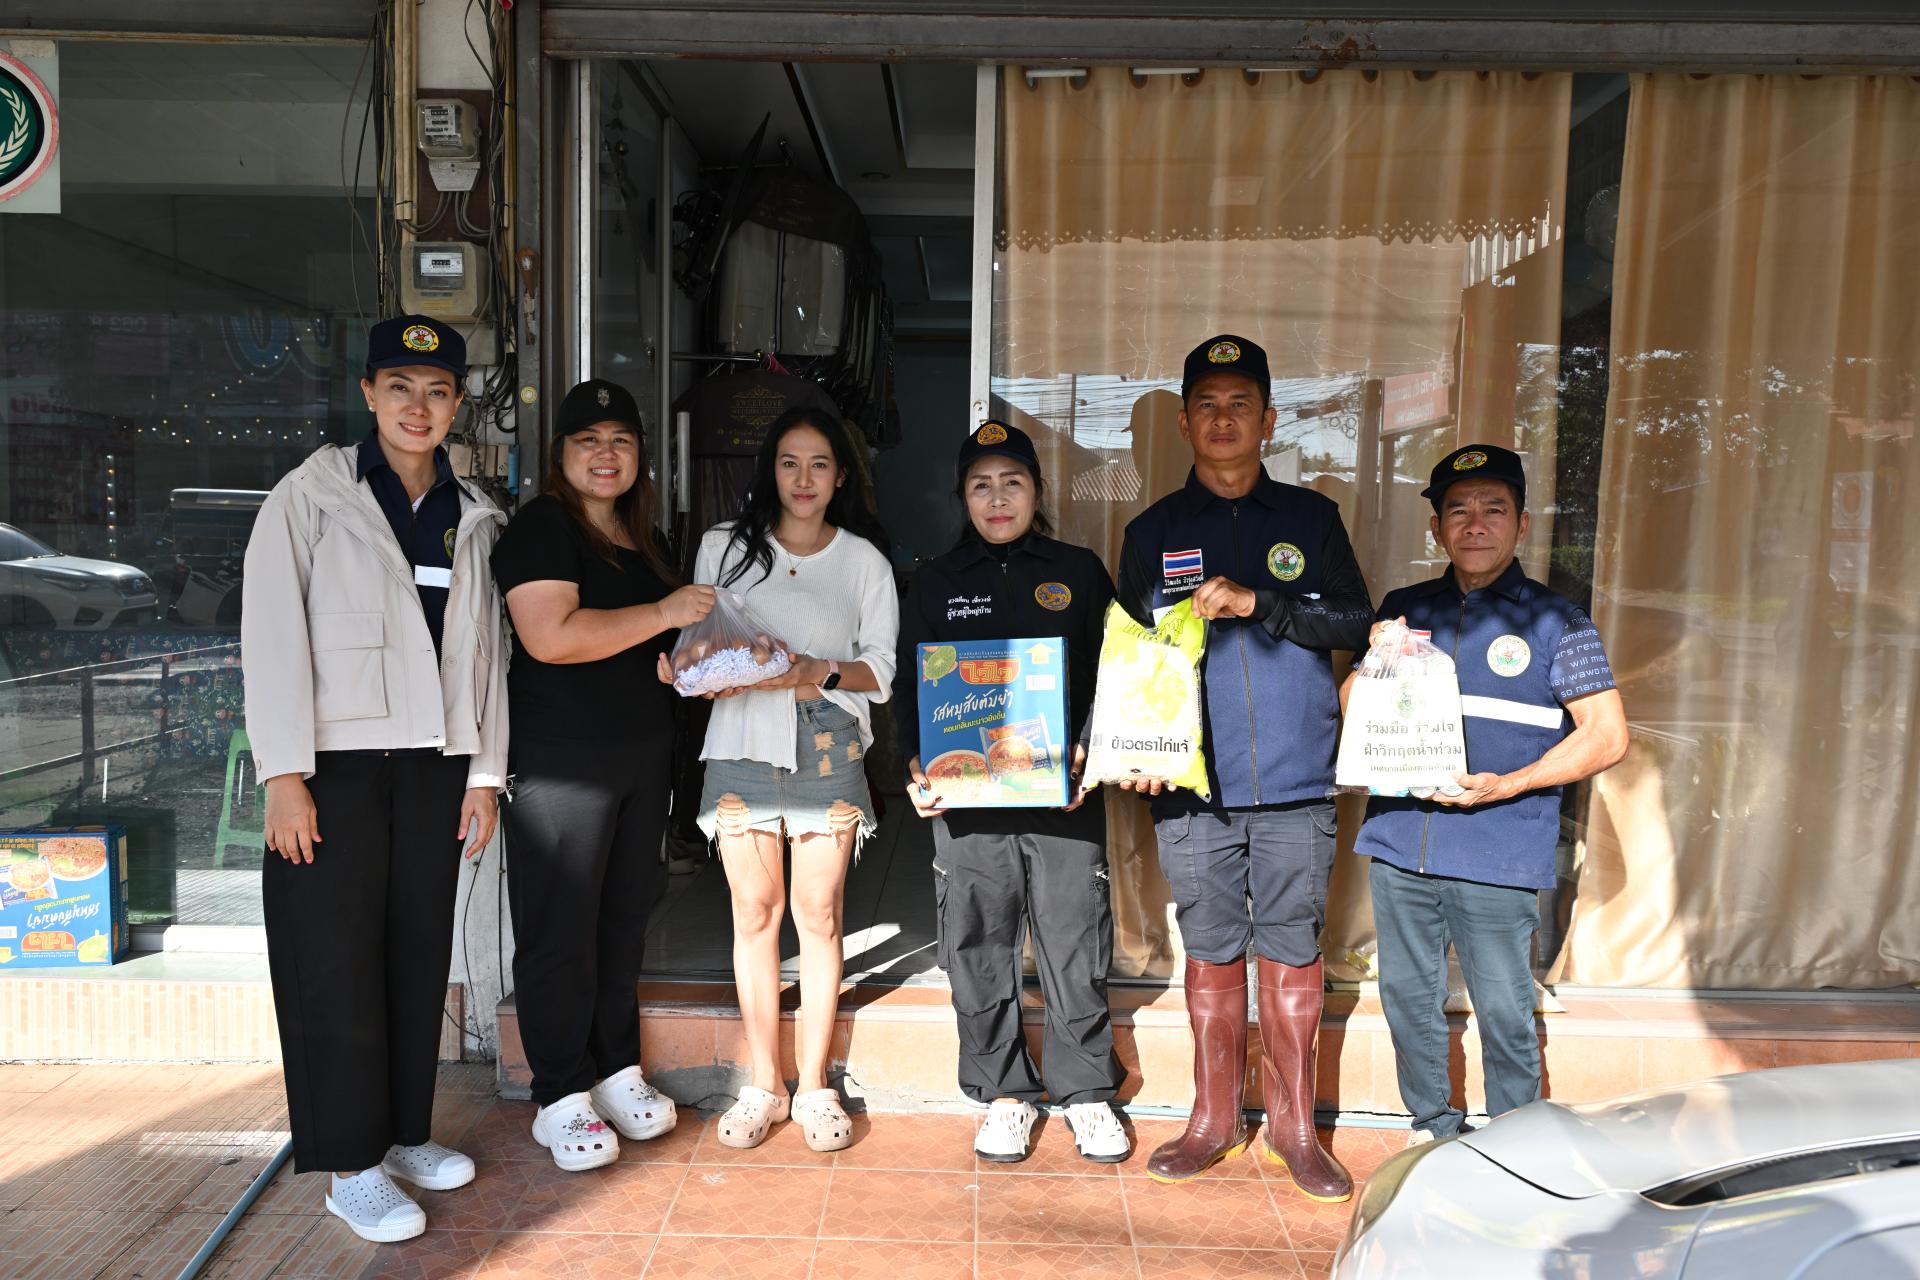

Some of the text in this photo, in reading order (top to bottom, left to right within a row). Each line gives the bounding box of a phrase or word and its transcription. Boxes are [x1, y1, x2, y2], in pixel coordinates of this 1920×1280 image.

[1364, 720, 1409, 734] ร่วมมือ
[1111, 736, 1189, 753] ข้าวตราไก่แจ้
[1364, 738, 1462, 759] ฝ่าวิกฤตน้ำท่วม
